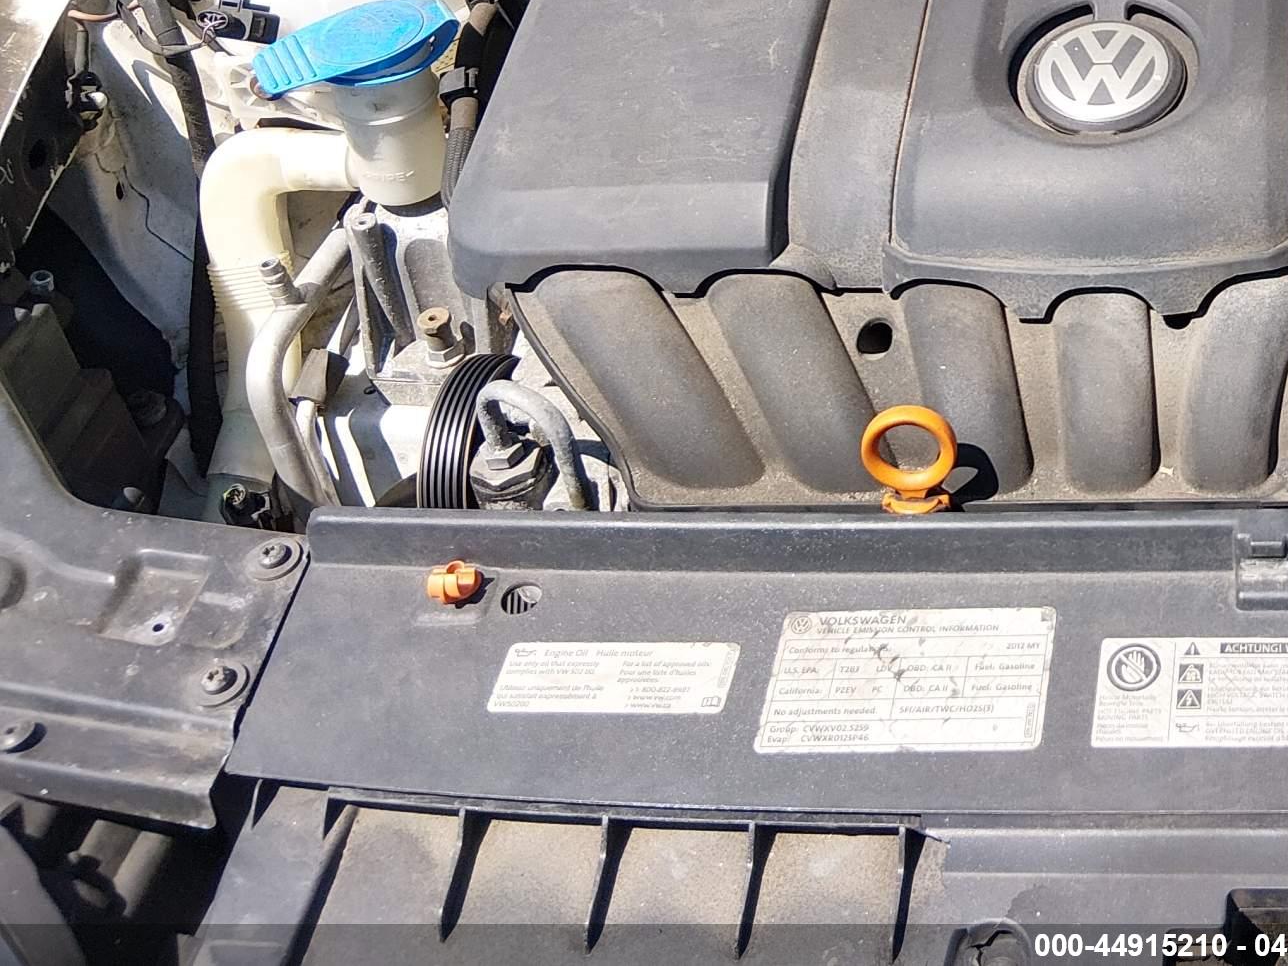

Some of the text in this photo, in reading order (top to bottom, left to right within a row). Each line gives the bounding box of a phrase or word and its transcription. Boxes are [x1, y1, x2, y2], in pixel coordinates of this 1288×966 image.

[818, 616, 907, 626] VOLKSWAGEN
[897, 626, 936, 634] CONTROL
[939, 624, 999, 633] INFORMATION
[1224, 643, 1282, 652] ACHTUNG!
[543, 649, 588, 659] Engine Oil
[998, 663, 1036, 671] Gasoline
[779, 687, 823, 696] California:
[996, 683, 1033, 691] Gasoline
[774, 707, 786, 716] No
[788, 707, 845, 716] adjustments
